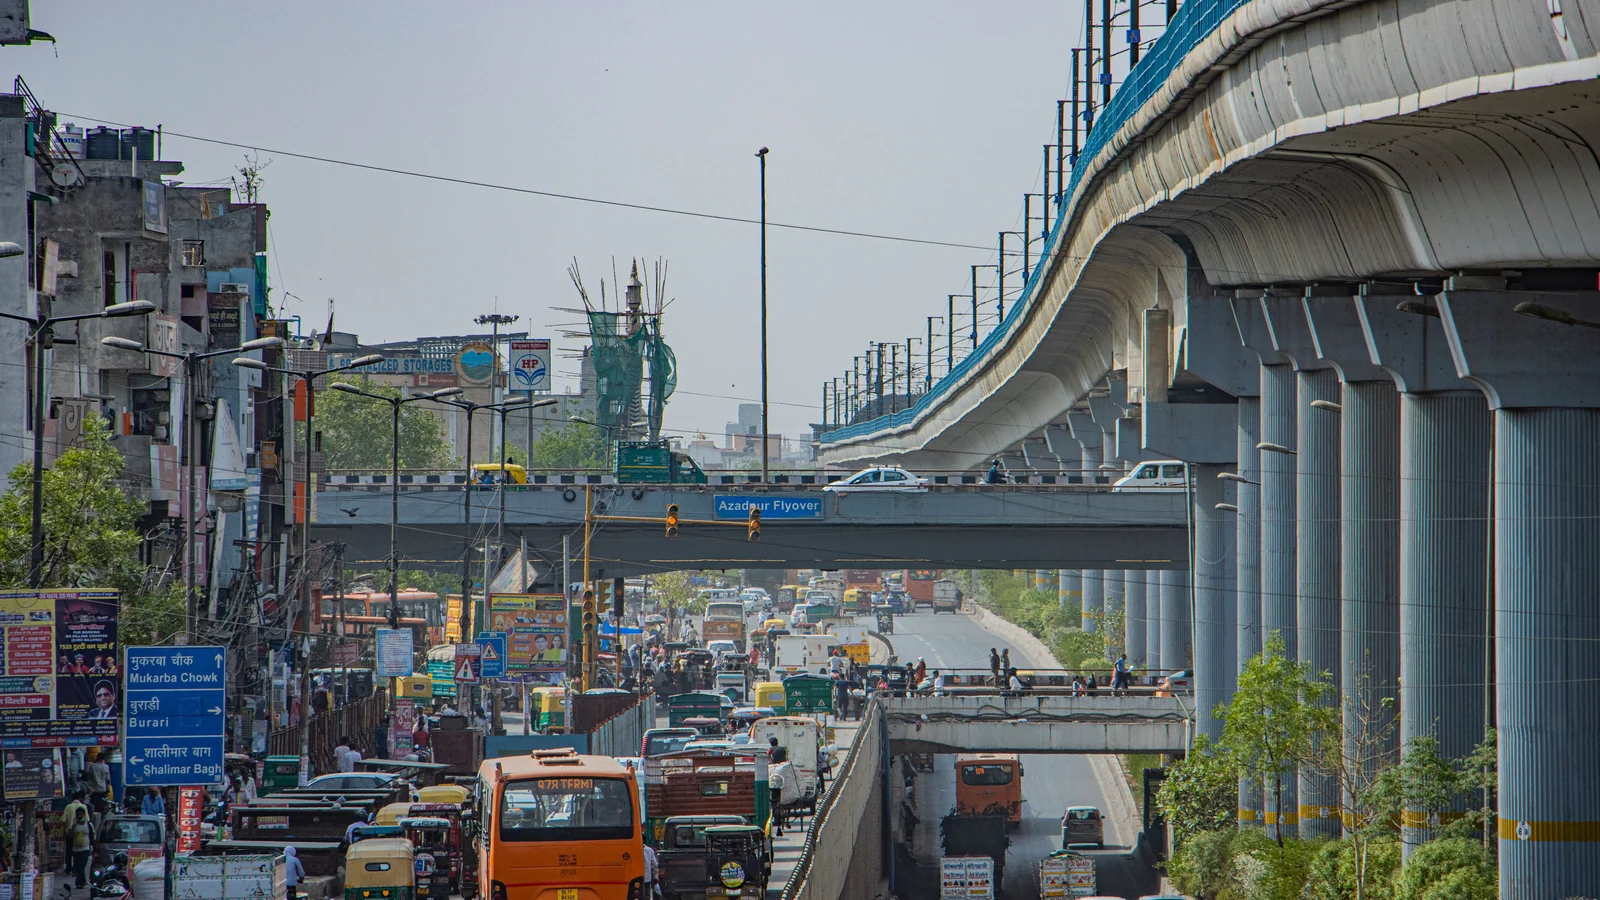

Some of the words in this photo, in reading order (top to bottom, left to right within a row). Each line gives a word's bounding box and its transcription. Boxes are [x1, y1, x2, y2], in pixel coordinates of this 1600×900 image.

[404, 358, 452, 372] STORAGES
[522, 360, 538, 368] HP
[773, 500, 819, 512] Flyover
[130, 656, 166, 670] मुकरबा
[170, 652, 193, 666] चौक
[130, 673, 177, 682] Mukarba
[181, 672, 218, 682] Chowk
[130, 696, 160, 714] बुराड़ी
[130, 717, 168, 727] Burari
[144, 744, 188, 758] शालीमार
[192, 747, 211, 757] बाग
[144, 764, 191, 775] Shalimar
[194, 764, 221, 776] Bagh
